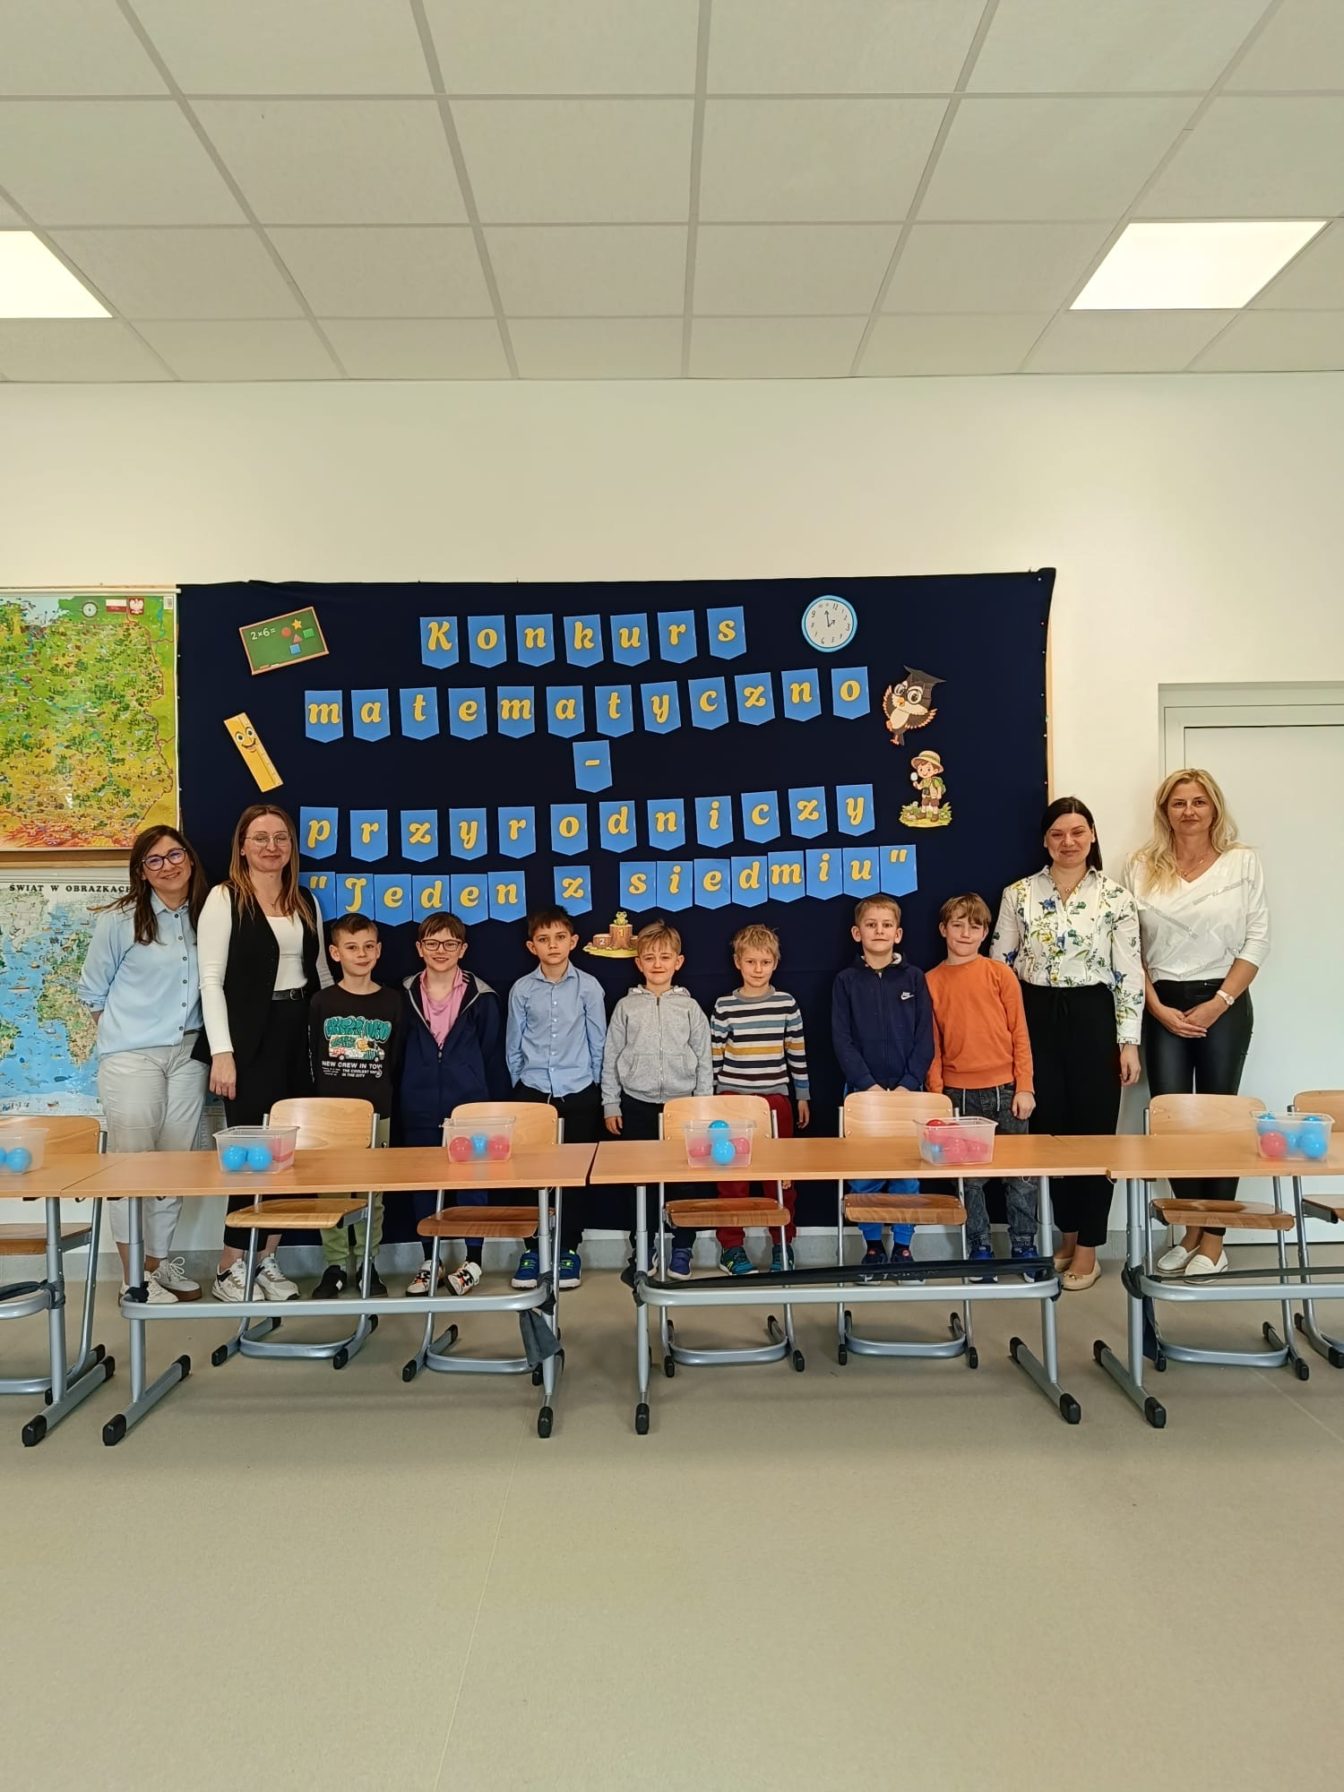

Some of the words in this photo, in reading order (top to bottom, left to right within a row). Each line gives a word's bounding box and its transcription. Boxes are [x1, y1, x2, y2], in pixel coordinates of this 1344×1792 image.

[427, 620, 737, 652] Konkurs
[308, 680, 862, 726] matematyczno
[307, 797, 866, 850] przyrodniczy
[50, 884, 60, 892] W
[562, 877, 585, 899] z
[628, 848, 908, 895] siedmiu"
[337, 1061, 358, 1069] CREW
